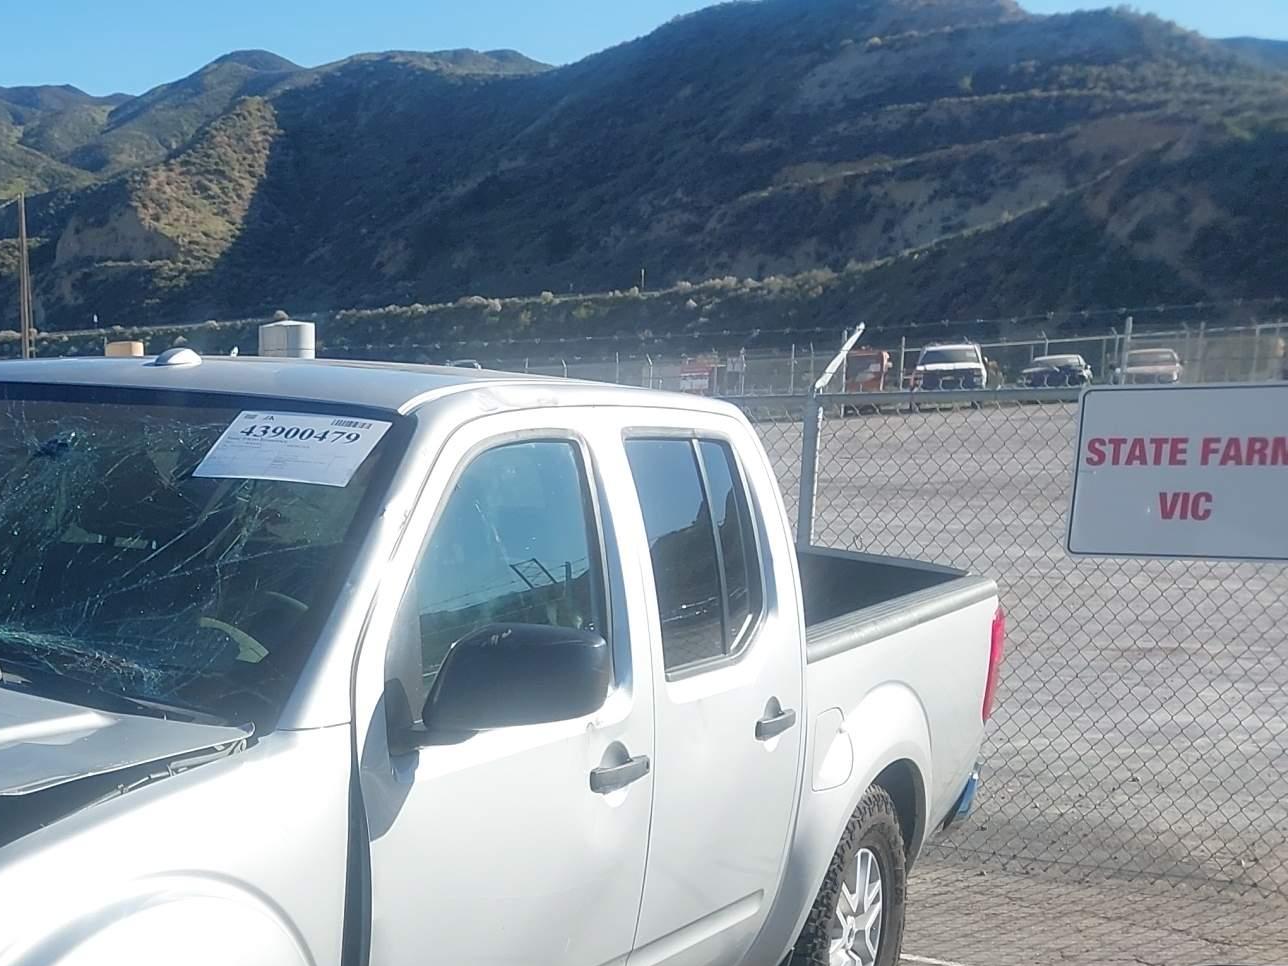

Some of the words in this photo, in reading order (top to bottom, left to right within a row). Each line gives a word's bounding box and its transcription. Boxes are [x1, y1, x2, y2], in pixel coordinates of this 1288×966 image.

[240, 423, 361, 444] 43900479
[1086, 437, 1189, 466] STATE
[1159, 491, 1212, 521] VIC
